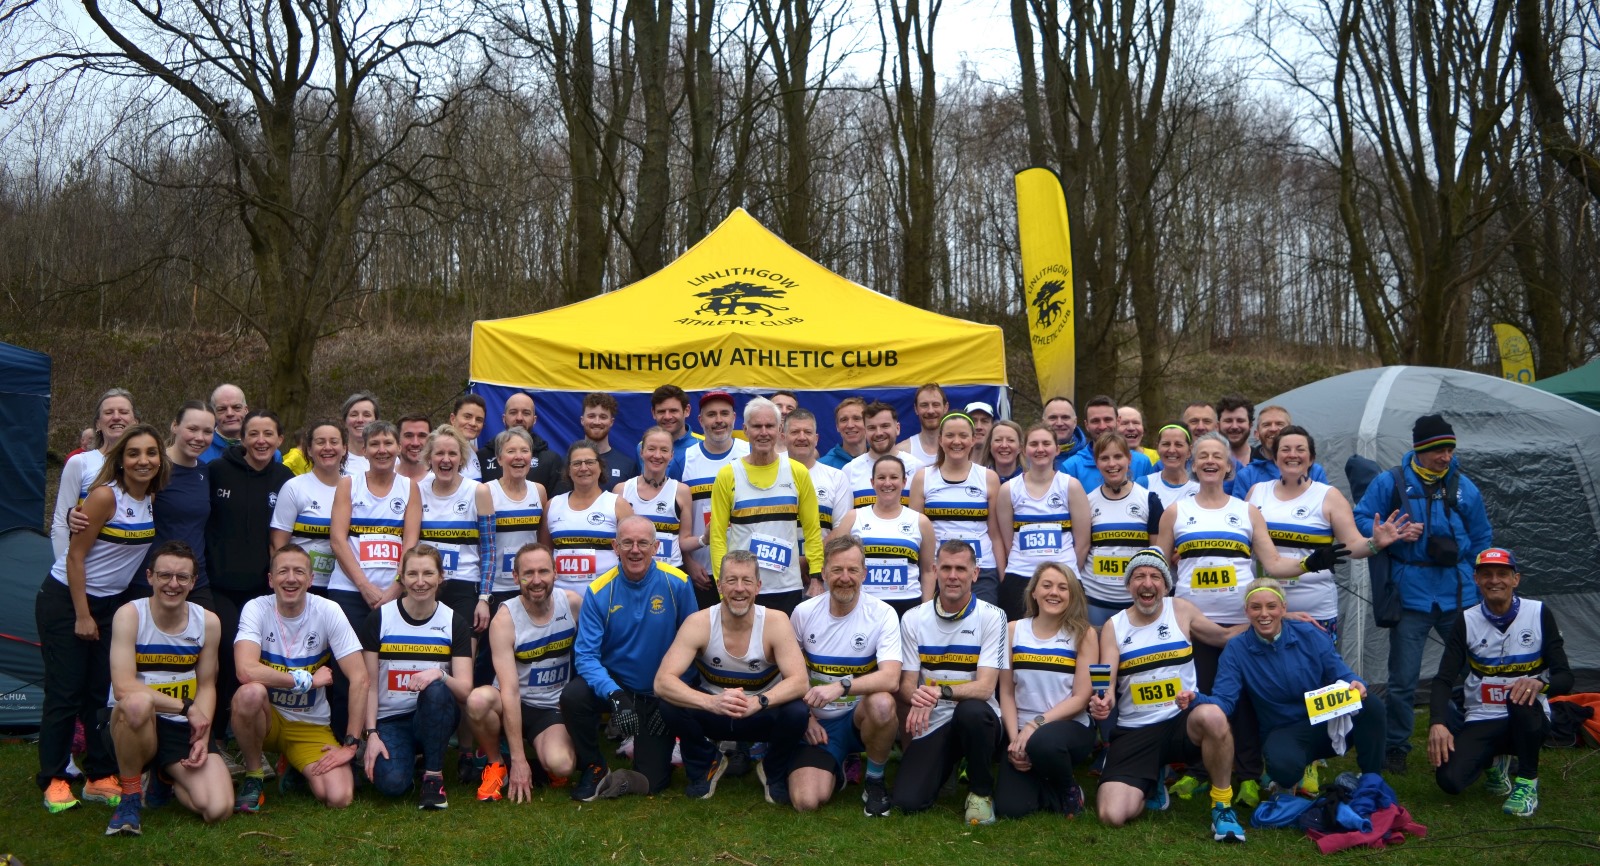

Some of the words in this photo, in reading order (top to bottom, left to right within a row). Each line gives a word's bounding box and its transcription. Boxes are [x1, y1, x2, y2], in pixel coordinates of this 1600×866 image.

[687, 267, 799, 290] LINLITHGOW
[1028, 264, 1069, 294] LINLITHGOW
[674, 317, 752, 327] ATHLETIC
[767, 316, 804, 327] CLUB
[577, 349, 722, 370] LINLITHGOW
[729, 347, 834, 368] ATHLETIC
[841, 350, 898, 368] CLUB
[486, 462, 497, 470] JL
[217, 488, 231, 499] CH
[303, 525, 330, 533] LINLIT
[1024, 533, 1045, 547] 153
[1047, 533, 1057, 546] A
[1182, 540, 1234, 550] LINLITHGOW
[367, 543, 390, 558] 143
[392, 545, 399, 559] D
[756, 543, 778, 560] 154
[777, 549, 786, 563] A
[864, 546, 907, 554] LITHGOW
[313, 555, 335, 570] 153
[443, 553, 451, 568] A
[560, 558, 578, 572] 144
[581, 558, 590, 572] D
[1098, 559, 1118, 573] 145
[869, 568, 891, 583] 142
[892, 568, 902, 583] A
[1196, 571, 1218, 586] 144
[1221, 569, 1230, 584] B
[386, 644, 432, 652] LINLITHGOW
[138, 655, 186, 663] LINLITHGOW
[1124, 651, 1167, 667] LINLITHGOW
[395, 673, 411, 689] 14
[536, 669, 557, 684] 148
[557, 666, 565, 681] A
[157, 686, 178, 699] 51
[181, 684, 190, 699] B
[272, 691, 297, 706] 149
[297, 693, 308, 706] A
[1138, 685, 1163, 701] 153
[1165, 683, 1176, 698] B
[1326, 689, 1352, 707] 140
[1487, 687, 1510, 702] 15
[1313, 696, 1325, 711] B
